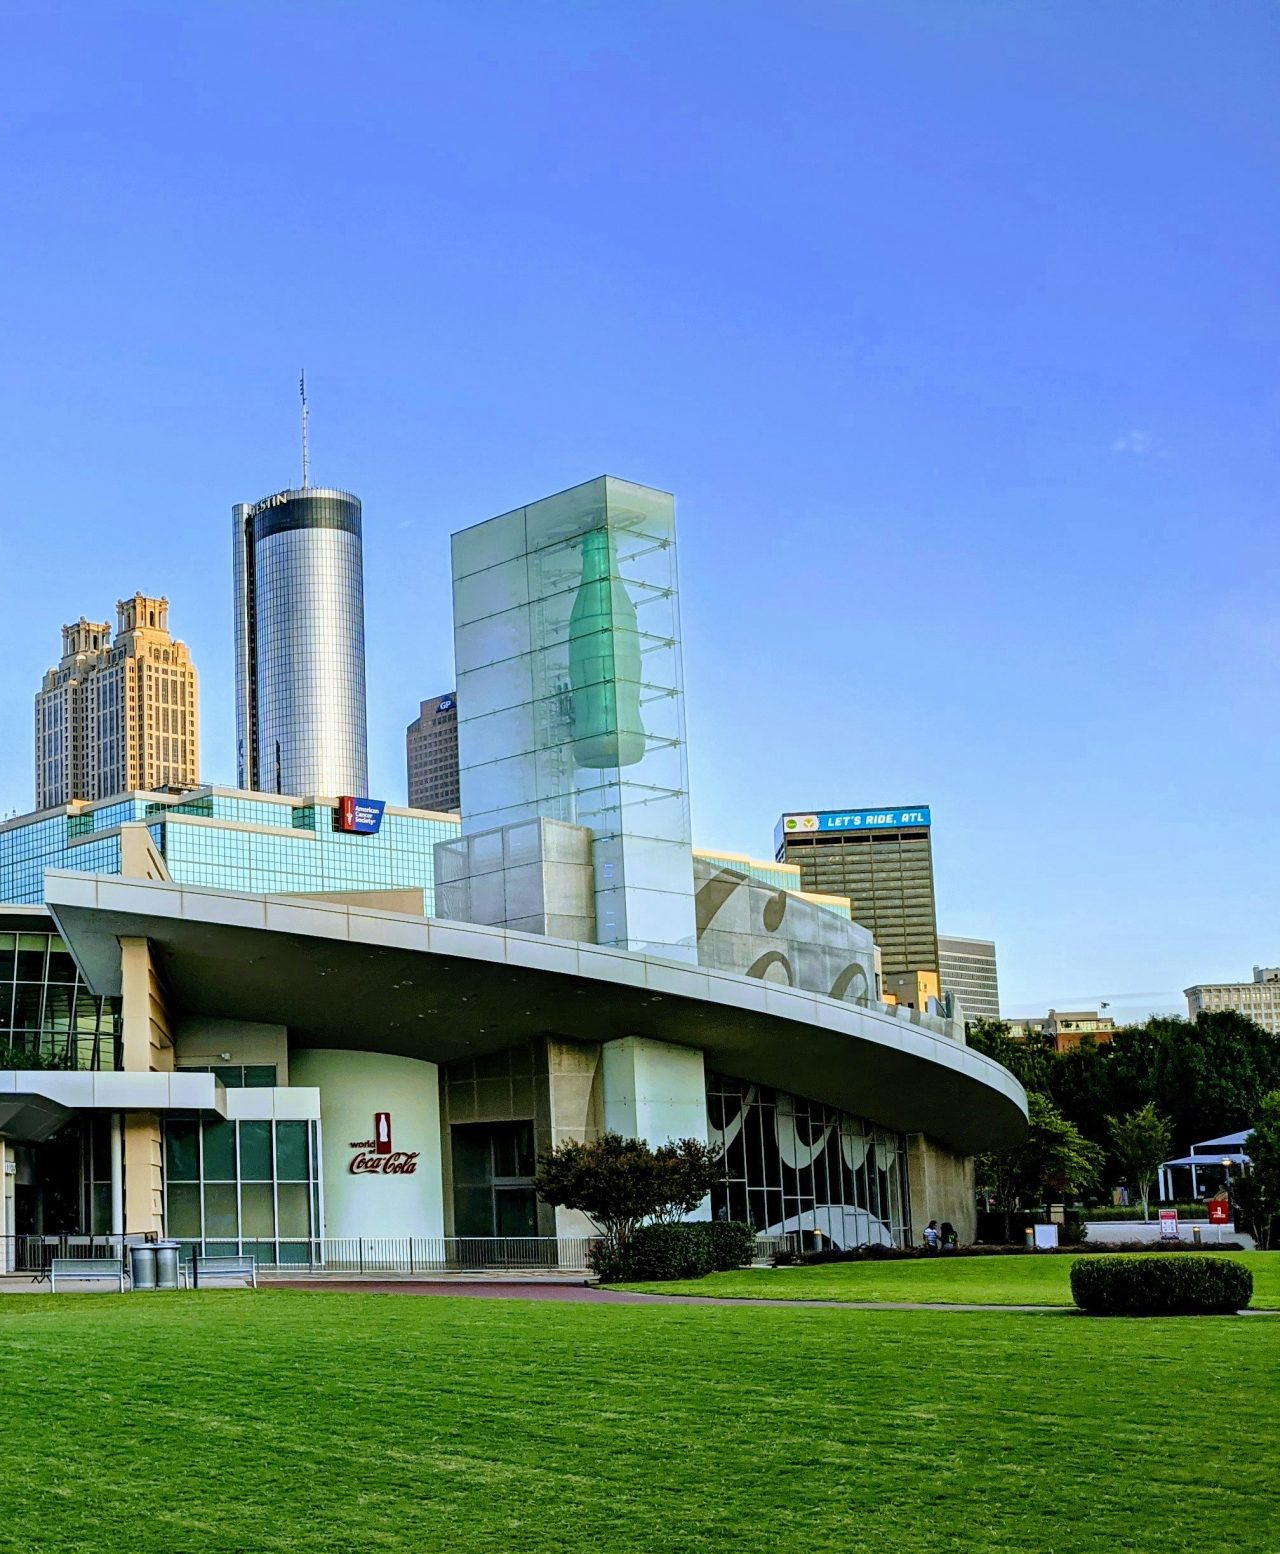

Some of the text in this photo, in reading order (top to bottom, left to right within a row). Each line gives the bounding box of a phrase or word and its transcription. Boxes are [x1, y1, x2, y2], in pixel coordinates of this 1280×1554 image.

[440, 700, 451, 710] GP
[355, 805, 379, 814] American
[355, 811, 374, 819] Cancer
[827, 812, 924, 827] LET'S RIDE, ATL
[349, 1140, 376, 1149] world
